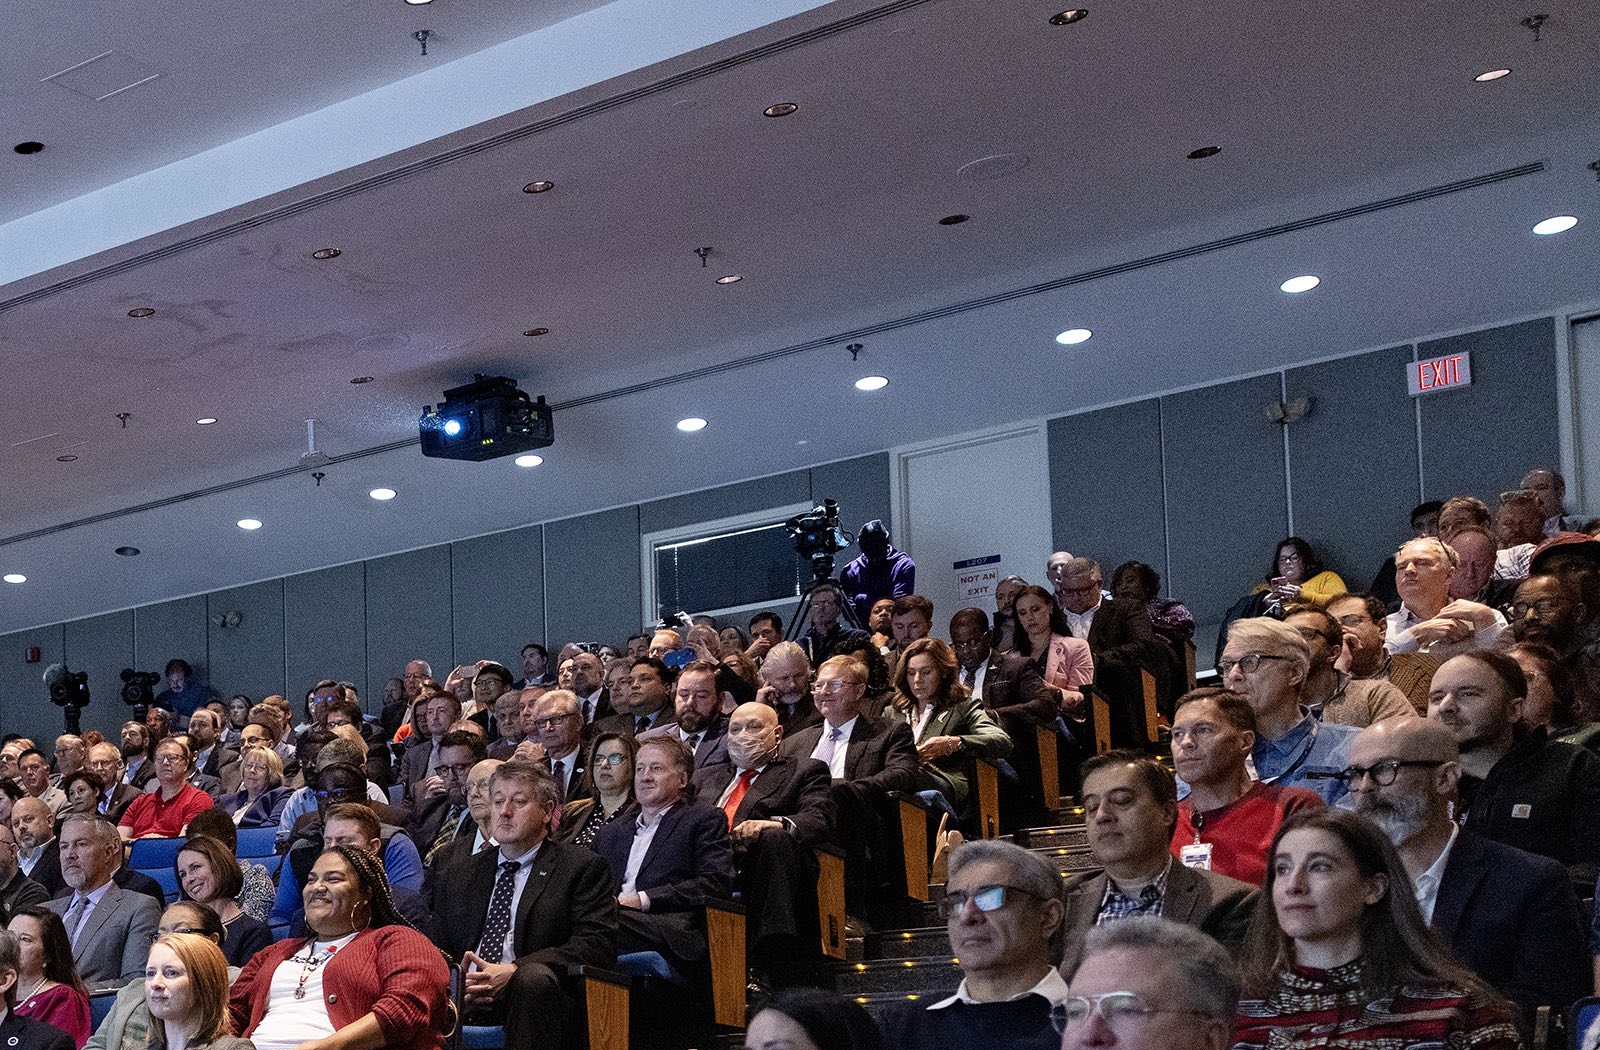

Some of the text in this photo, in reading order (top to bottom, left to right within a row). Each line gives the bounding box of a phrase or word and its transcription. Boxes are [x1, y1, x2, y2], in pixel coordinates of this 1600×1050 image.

[1418, 355, 1463, 390] EXIT
[960, 572, 996, 584] NOT AN
[967, 586, 989, 595] EXIT
